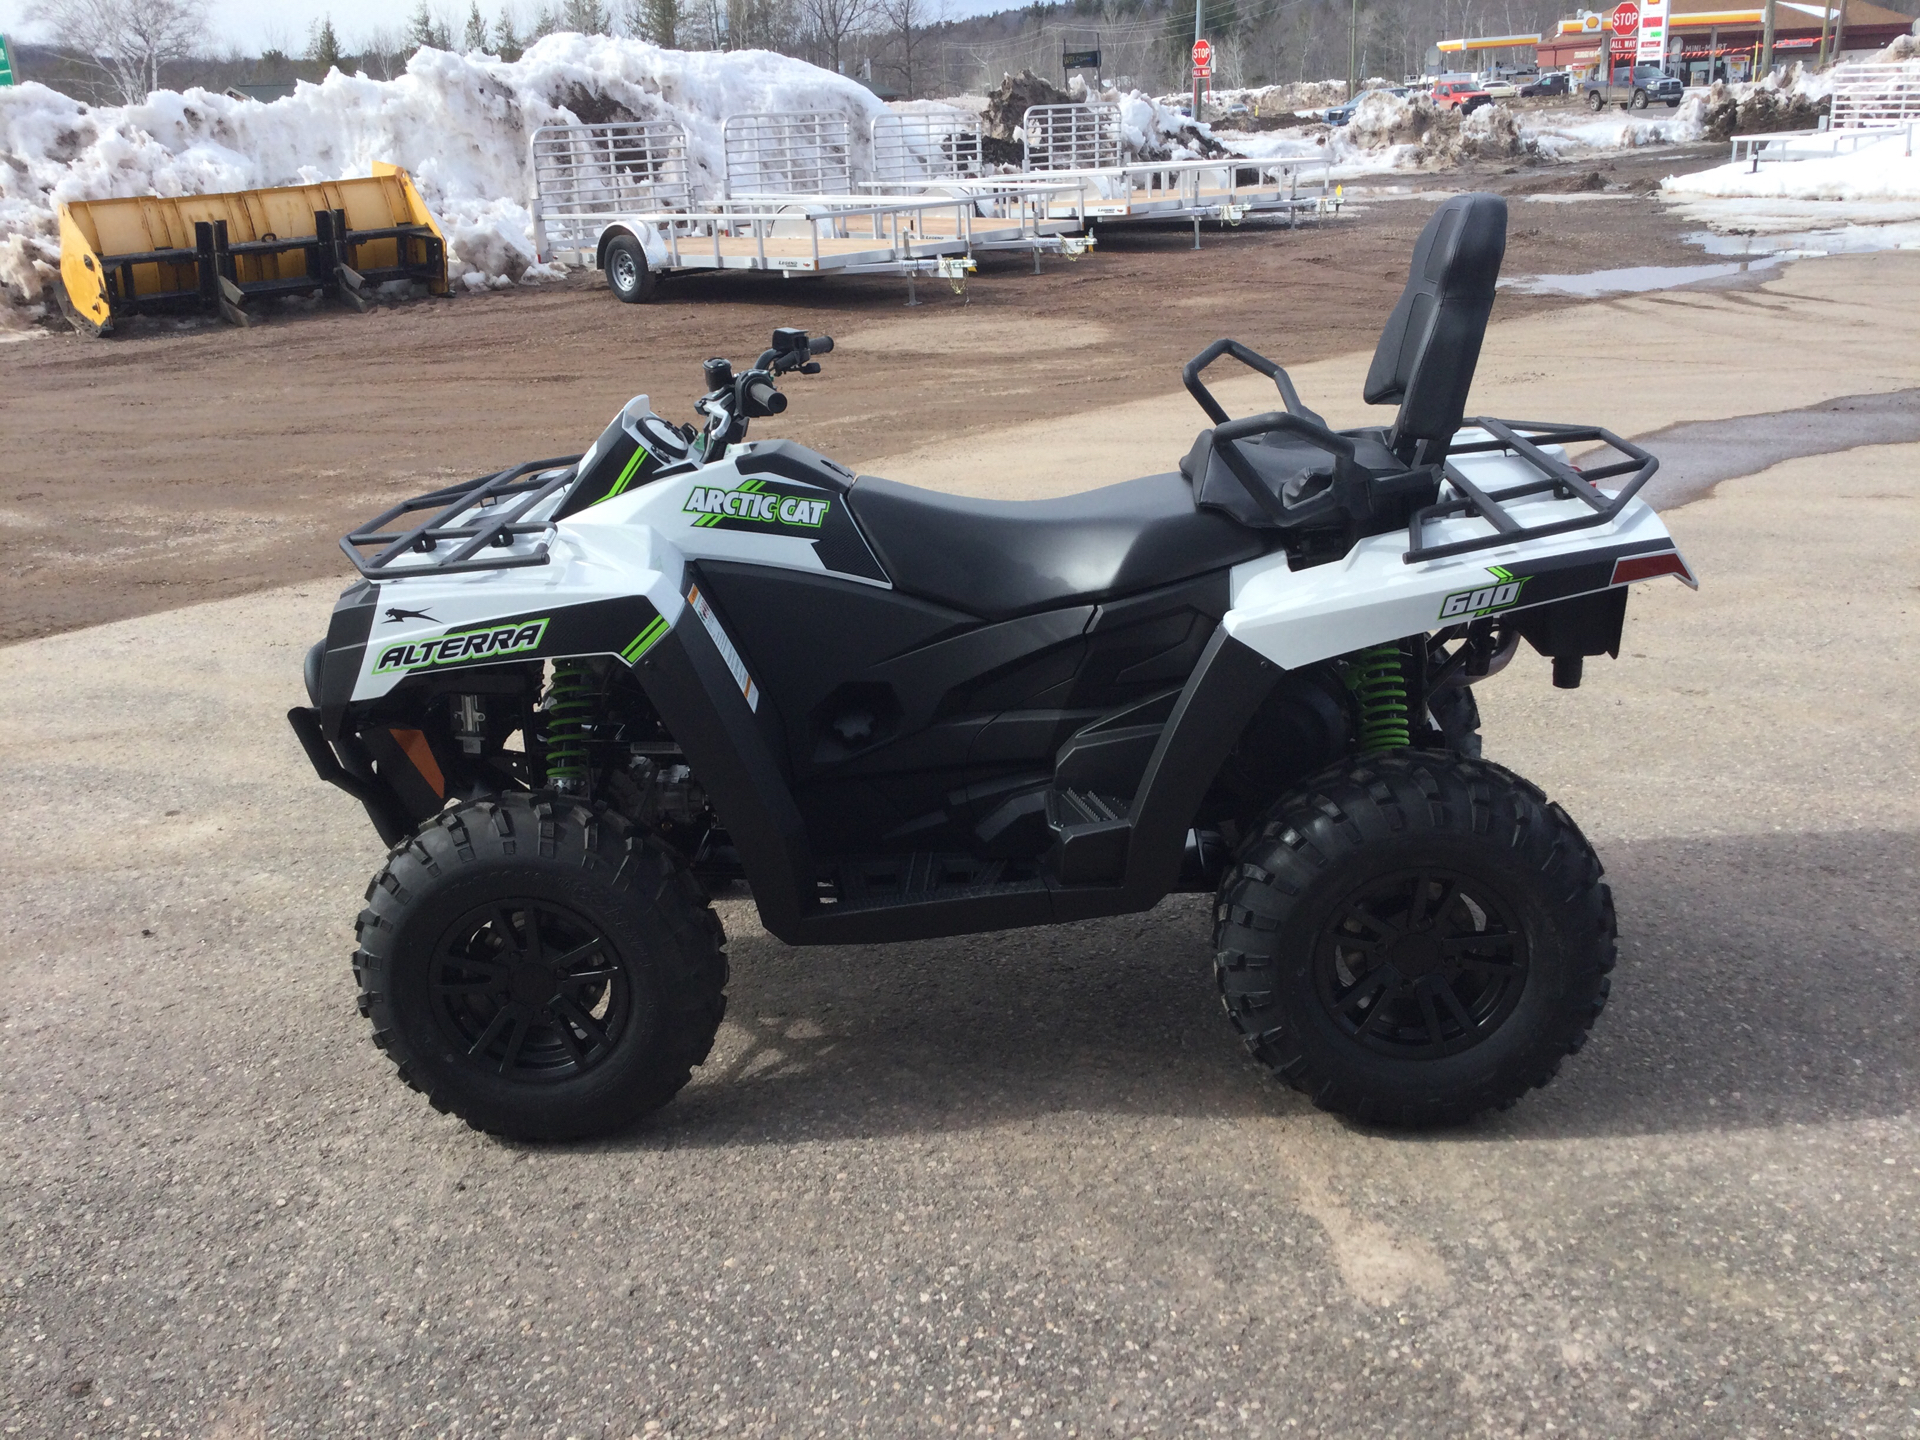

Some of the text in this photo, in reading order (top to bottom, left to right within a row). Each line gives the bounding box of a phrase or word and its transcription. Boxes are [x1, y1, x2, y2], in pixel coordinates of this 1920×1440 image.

[1613, 12, 1638, 27] STOP
[1611, 41, 1622, 49] ALL
[1624, 39, 1637, 48] WAY
[1685, 43, 1728, 52] MINI-MRT
[1193, 48, 1210, 59] STOP
[684, 487, 829, 526] ARCTIC CAT
[1442, 582, 1521, 617] 600
[377, 622, 543, 670] ALTERRA
